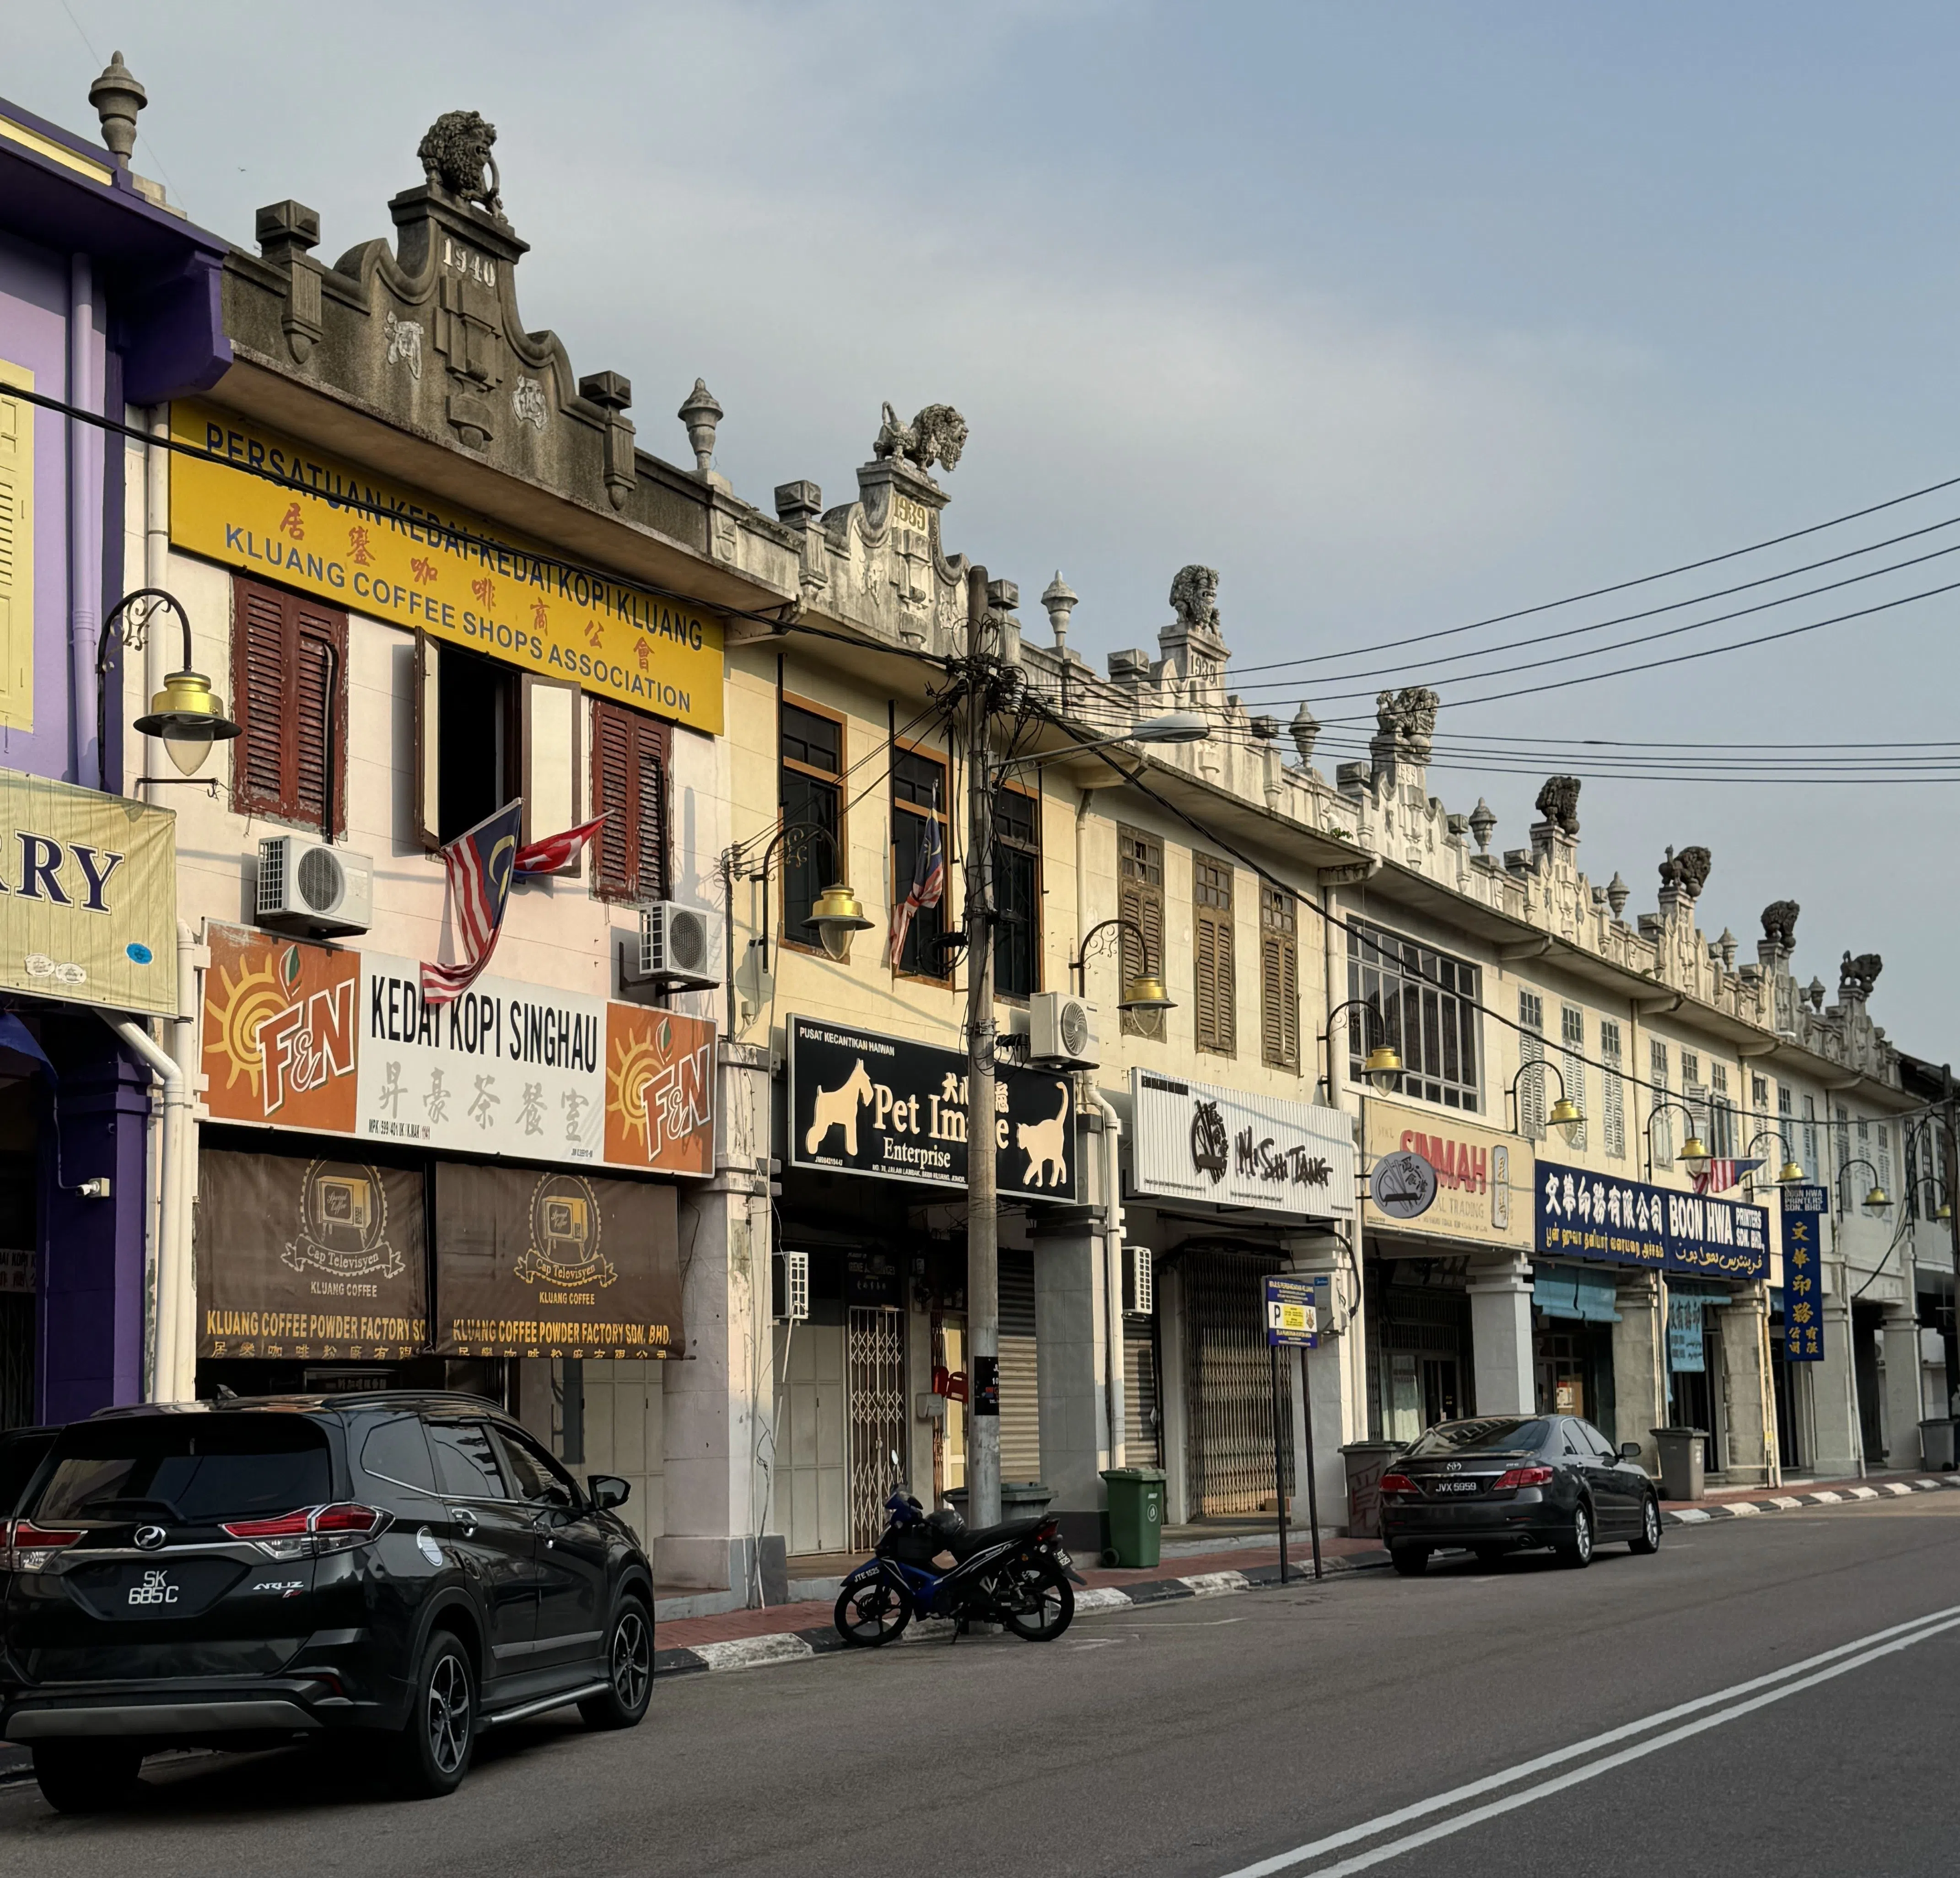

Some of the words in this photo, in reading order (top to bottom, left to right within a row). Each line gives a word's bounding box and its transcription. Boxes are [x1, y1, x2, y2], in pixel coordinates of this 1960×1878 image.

[443, 238, 495, 287] 1940
[207, 422, 381, 525] PERSATUAN
[559, 570, 610, 616] KOPI
[618, 589, 702, 651] KLUANG
[226, 522, 345, 588] KLUANG
[354, 572, 455, 629] COFFEE
[463, 611, 543, 660] SHOPS
[549, 643, 691, 714] ASSOCIATION
[0, 829, 125, 915] RY
[372, 974, 441, 1048] KEDAI
[450, 991, 501, 1057] KOPI
[510, 1000, 598, 1073] SINGHAU
[255, 977, 355, 1116] F&N
[800, 1027, 823, 1041] PUSAT
[824, 1032, 868, 1050] KECANTIKAN
[869, 1041, 895, 1057] HAIWAN
[640, 1043, 711, 1162] F&N
[873, 1083, 920, 1135] Pet
[928, 1094, 1009, 1150] Ime
[883, 1136, 951, 1169] Enterprise
[1449, 1197, 1484, 1219] TRADING
[1669, 1195, 1703, 1241] BOON
[1706, 1201, 1734, 1245] HWA
[1736, 1207, 1761, 1229] PRINTERS
[307, 1245, 326, 1265] Cap
[328, 1250, 379, 1270] Televisyen
[535, 1259, 551, 1277] Cap
[552, 1264, 596, 1281] Televisyen
[310, 1281, 345, 1295] KLUANG
[346, 1283, 377, 1297] COFFEE
[539, 1291, 567, 1305] KLUANG
[569, 1292, 595, 1305] COFFEE
[207, 1310, 258, 1335] KLUANG
[261, 1312, 307, 1337] COFFEE
[310, 1314, 358, 1340] POWDER
[361, 1317, 410, 1341] FACTORY
[1274, 1304, 1281, 1326] P
[452, 1318, 496, 1342] KLUANG
[499, 1320, 537, 1342] COFFEE
[539, 1322, 580, 1343] POWDER
[582, 1323, 624, 1344] FACTORY
[626, 1324, 646, 1345] SDN.
[648, 1324, 672, 1345] BHD.
[1435, 1483, 1452, 1492] JVX
[143, 1570, 168, 1587] SK
[854, 1571, 867, 1583] JTE
